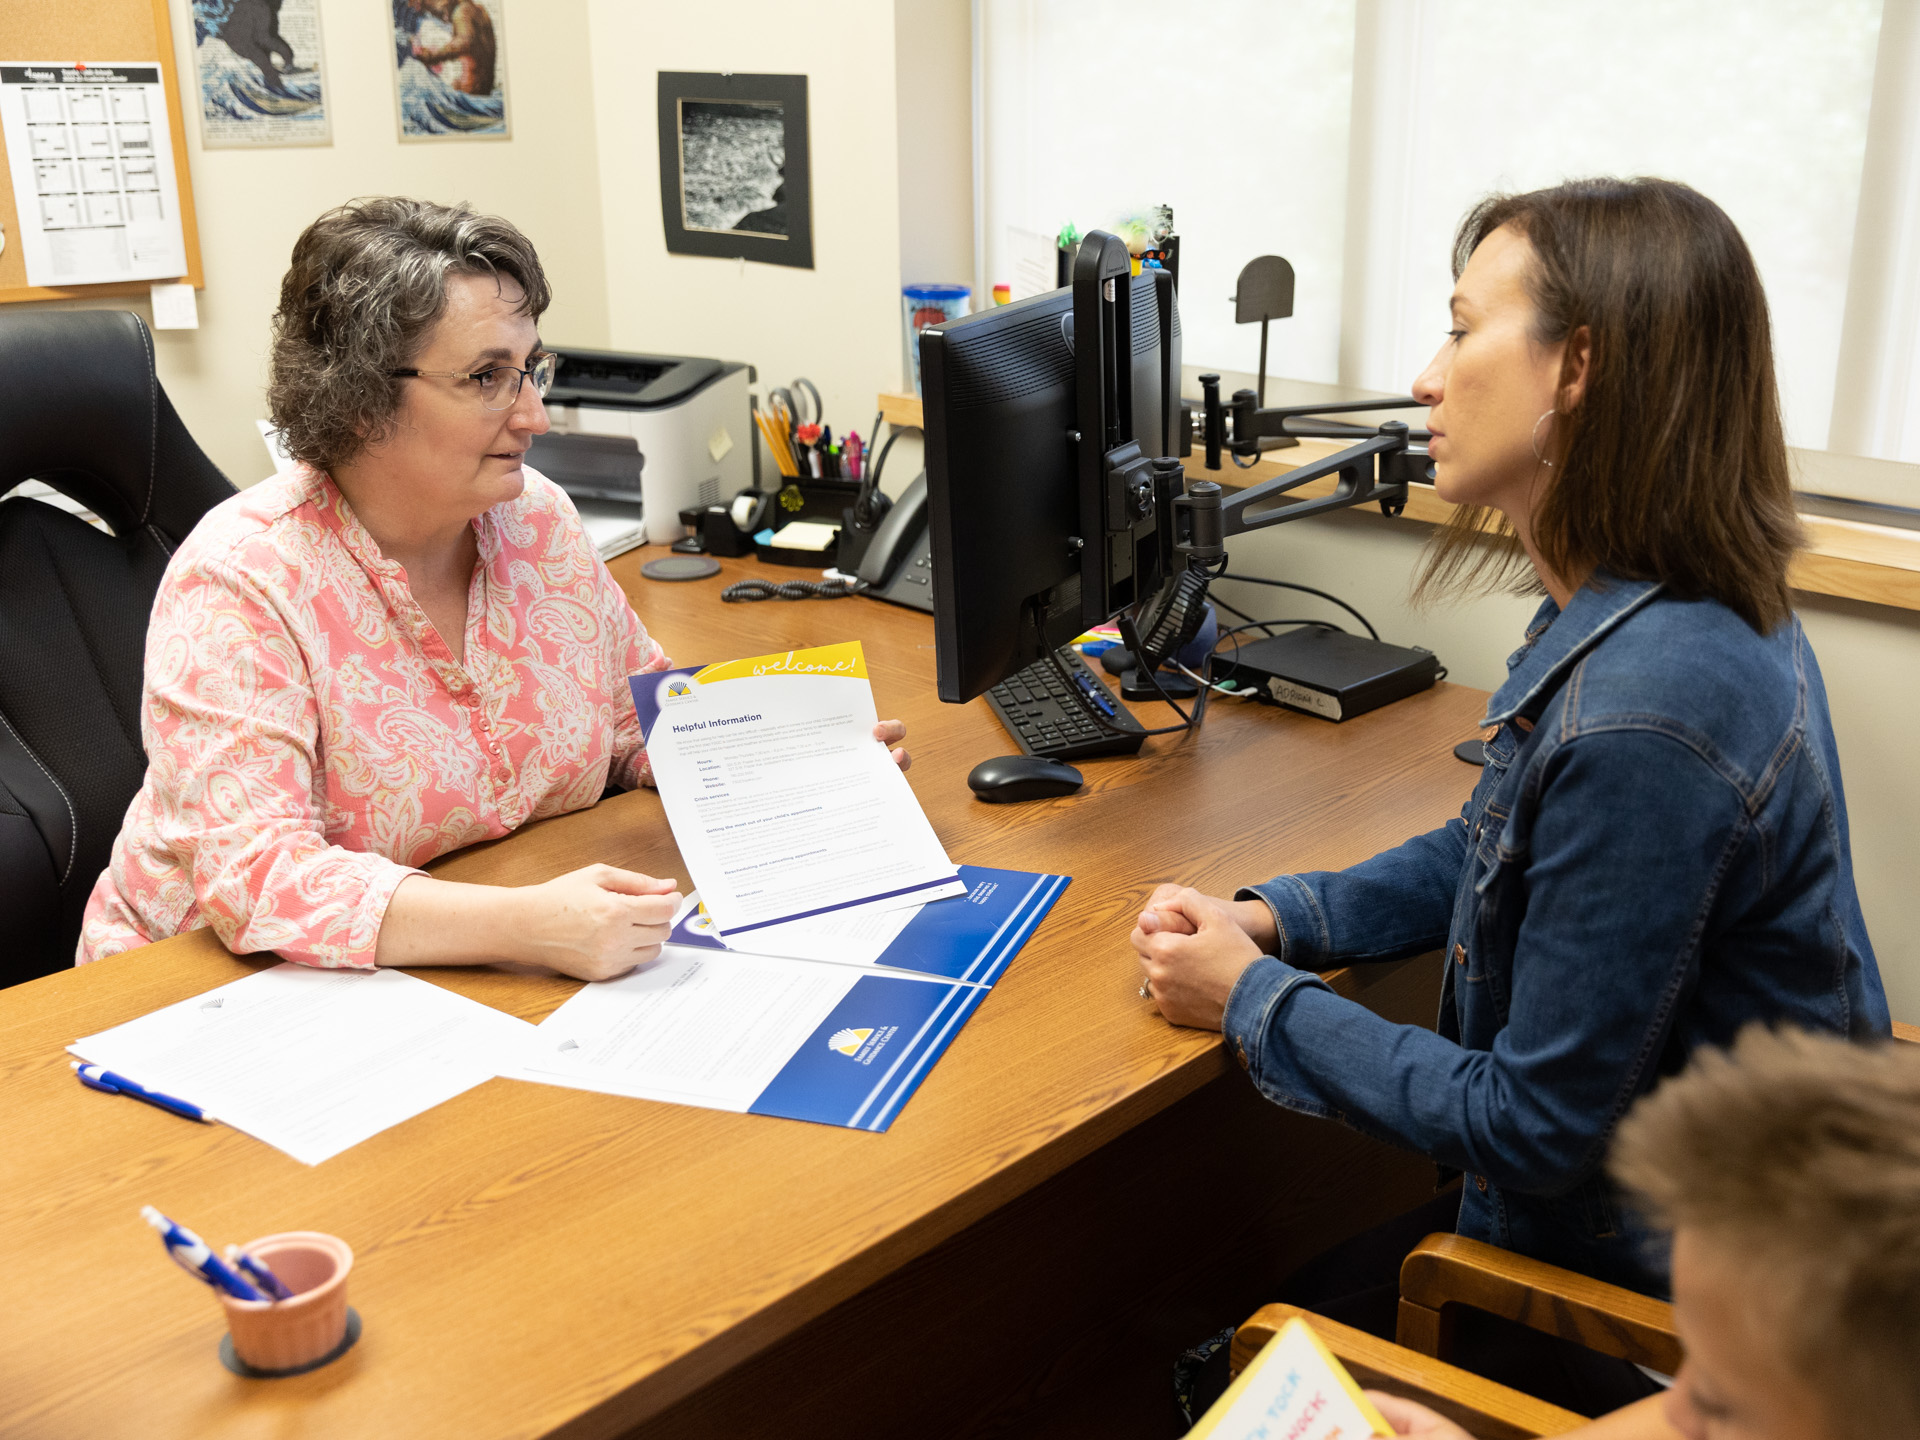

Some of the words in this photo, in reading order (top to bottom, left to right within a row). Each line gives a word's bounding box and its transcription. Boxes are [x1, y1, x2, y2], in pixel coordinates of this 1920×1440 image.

[753, 651, 856, 676] welcome!
[672, 721, 707, 733] Helpful
[708, 713, 762, 728] Information
